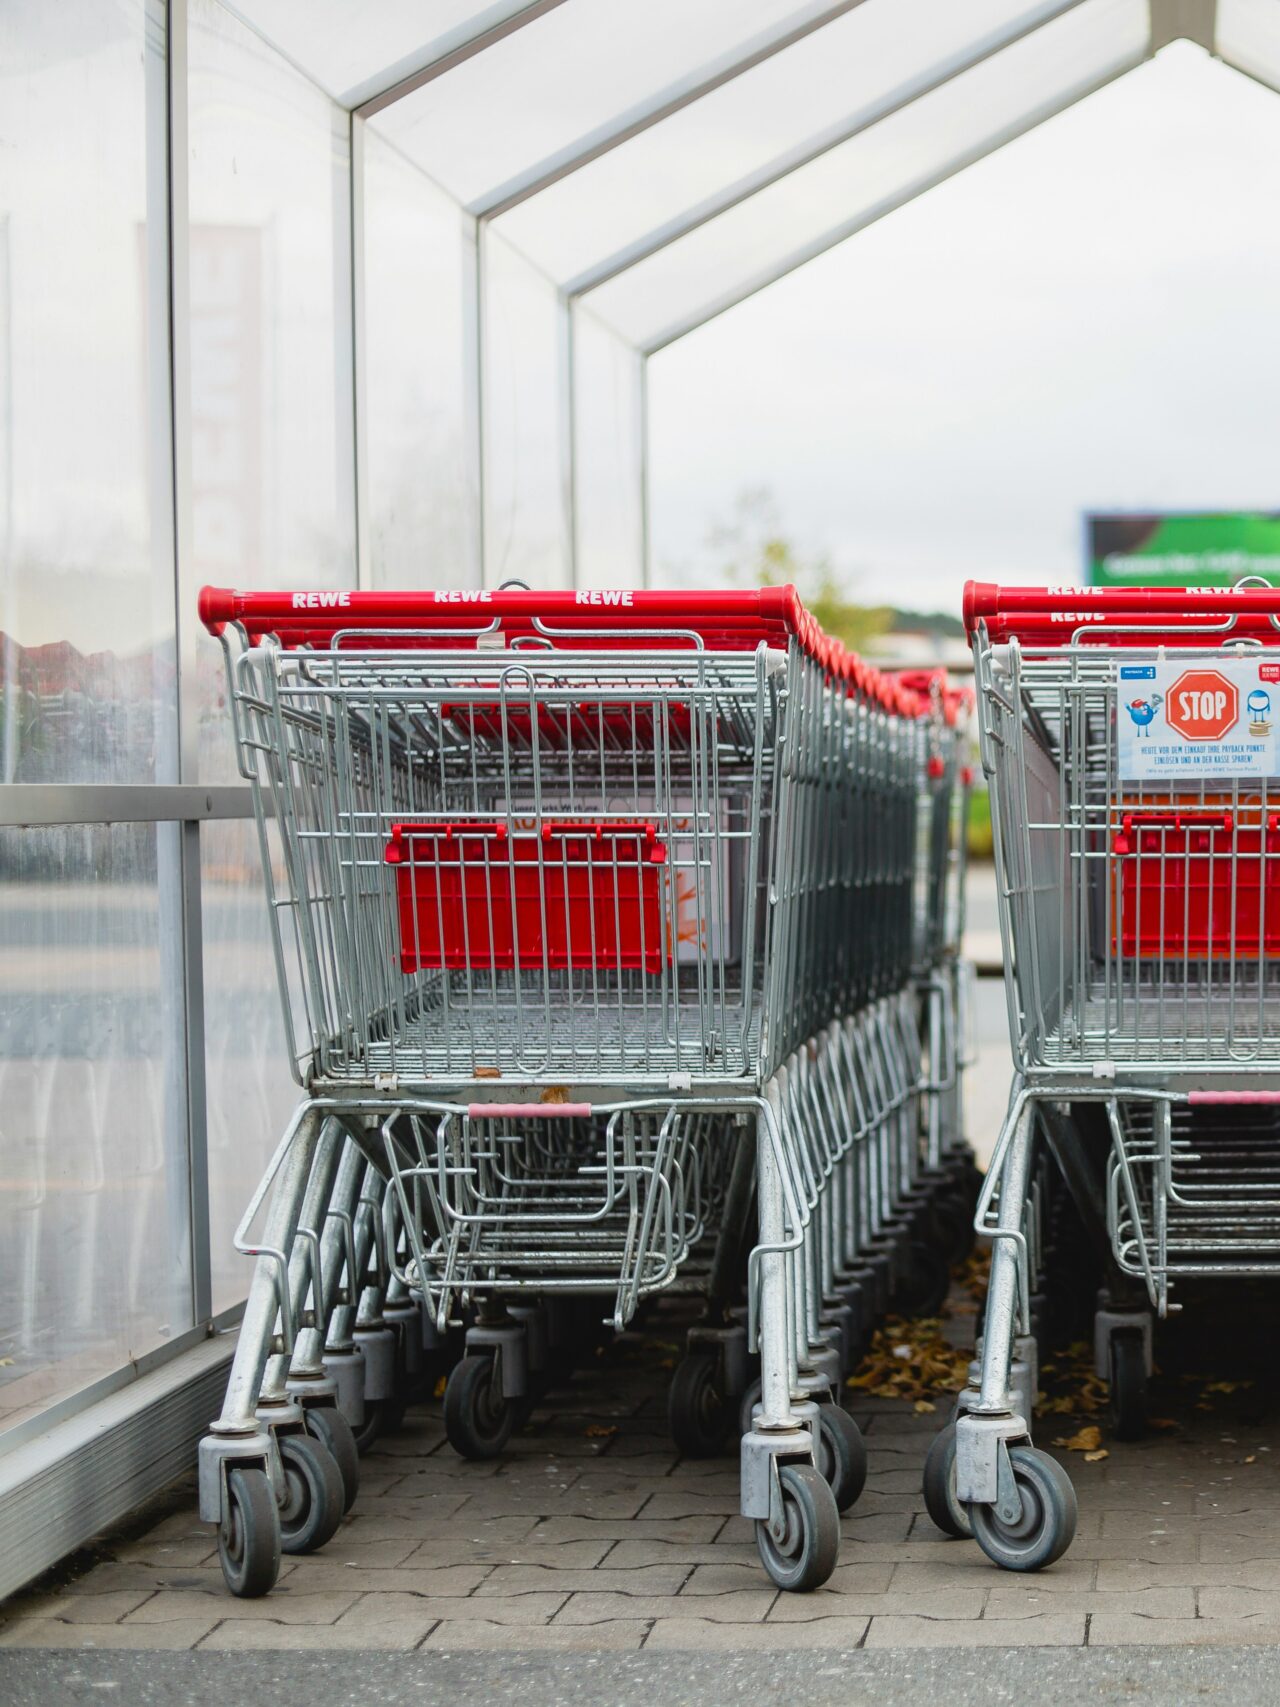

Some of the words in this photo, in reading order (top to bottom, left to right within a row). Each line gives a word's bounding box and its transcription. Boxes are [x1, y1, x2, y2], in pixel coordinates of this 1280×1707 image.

[292, 591, 351, 609] REWE
[434, 590, 493, 603] REWE
[576, 590, 634, 607] REWE
[1178, 691, 1227, 721] STOP
[1141, 746, 1156, 755] HEUTE
[1171, 746, 1182, 754] DEM
[1185, 745, 1206, 754] EINKAUF
[1222, 744, 1244, 753] PAYBACK
[1246, 744, 1265, 752] PUNKTE
[1181, 755, 1191, 764] UND
[1194, 755, 1200, 764] AN
[1202, 755, 1212, 764] DER
[1214, 754, 1230, 763] KASSE
